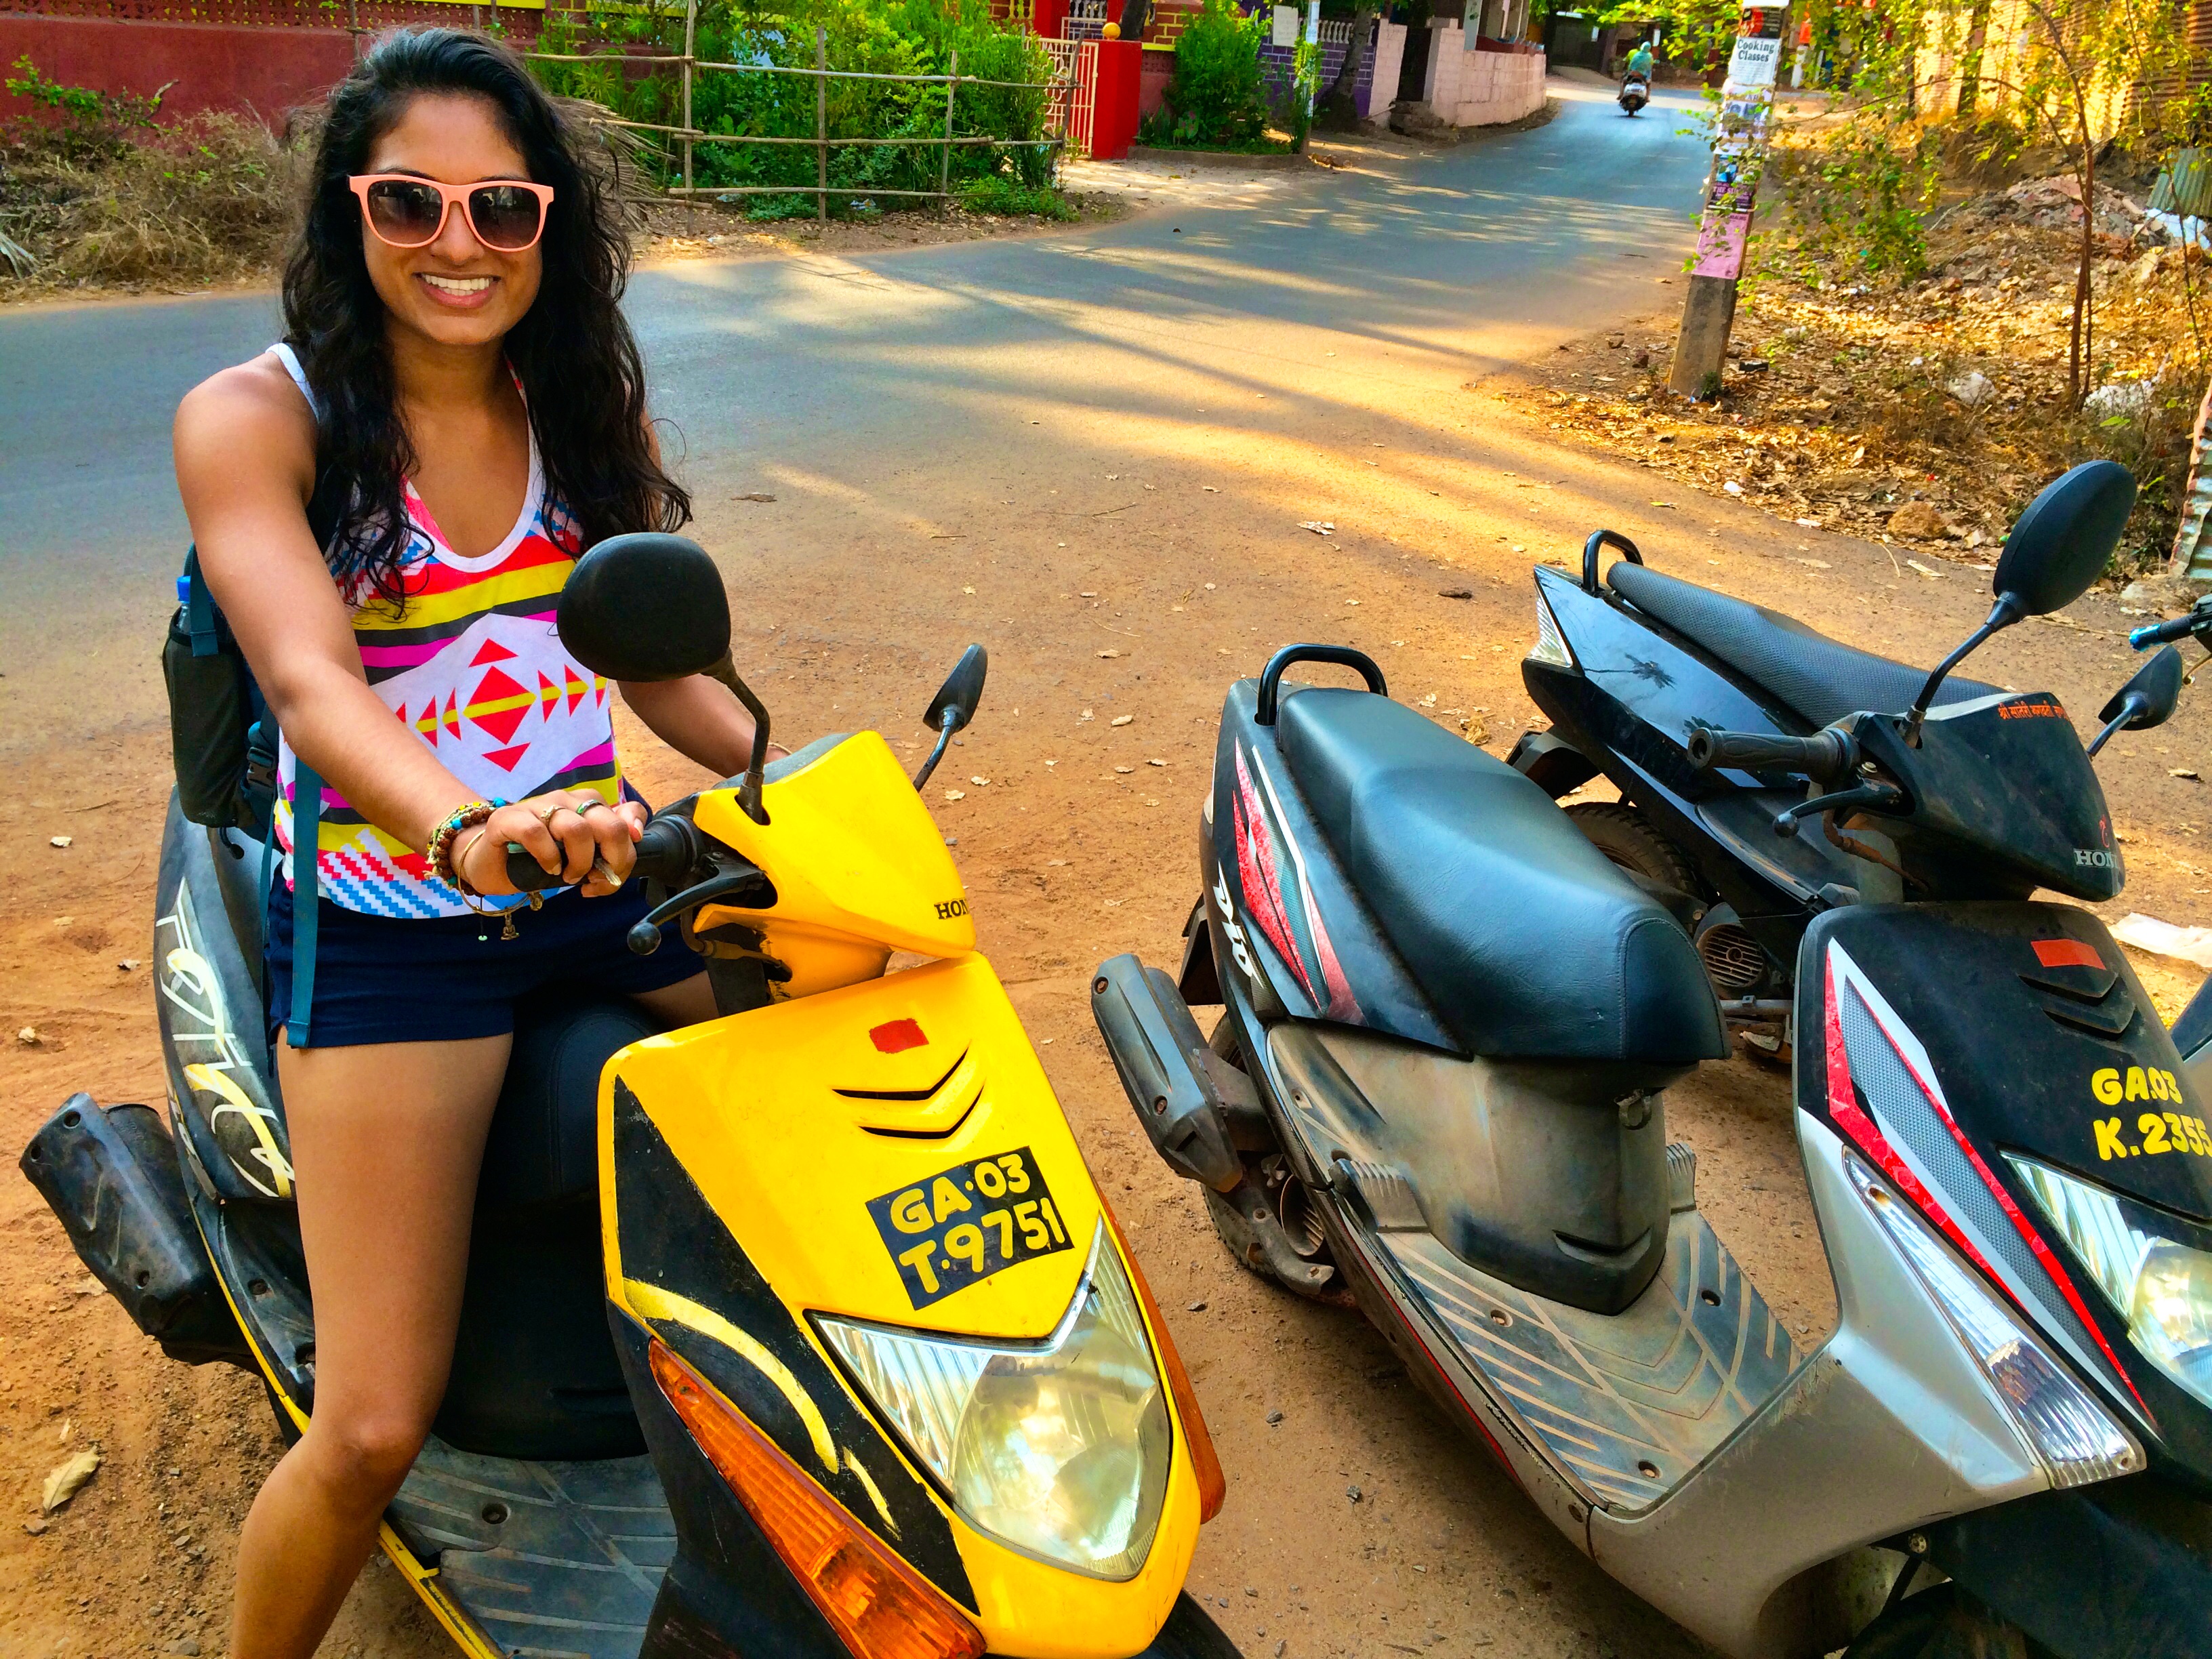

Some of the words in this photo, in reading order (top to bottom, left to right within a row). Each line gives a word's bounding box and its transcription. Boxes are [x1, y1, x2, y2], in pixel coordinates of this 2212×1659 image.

[1737, 39, 1775, 54] Cooking
[1738, 50, 1769, 62] Classes
[2091, 1067, 2183, 1105] GA.03
[2093, 1112, 2212, 1161] K.2355
[899, 1197, 1066, 1294] T.9751
